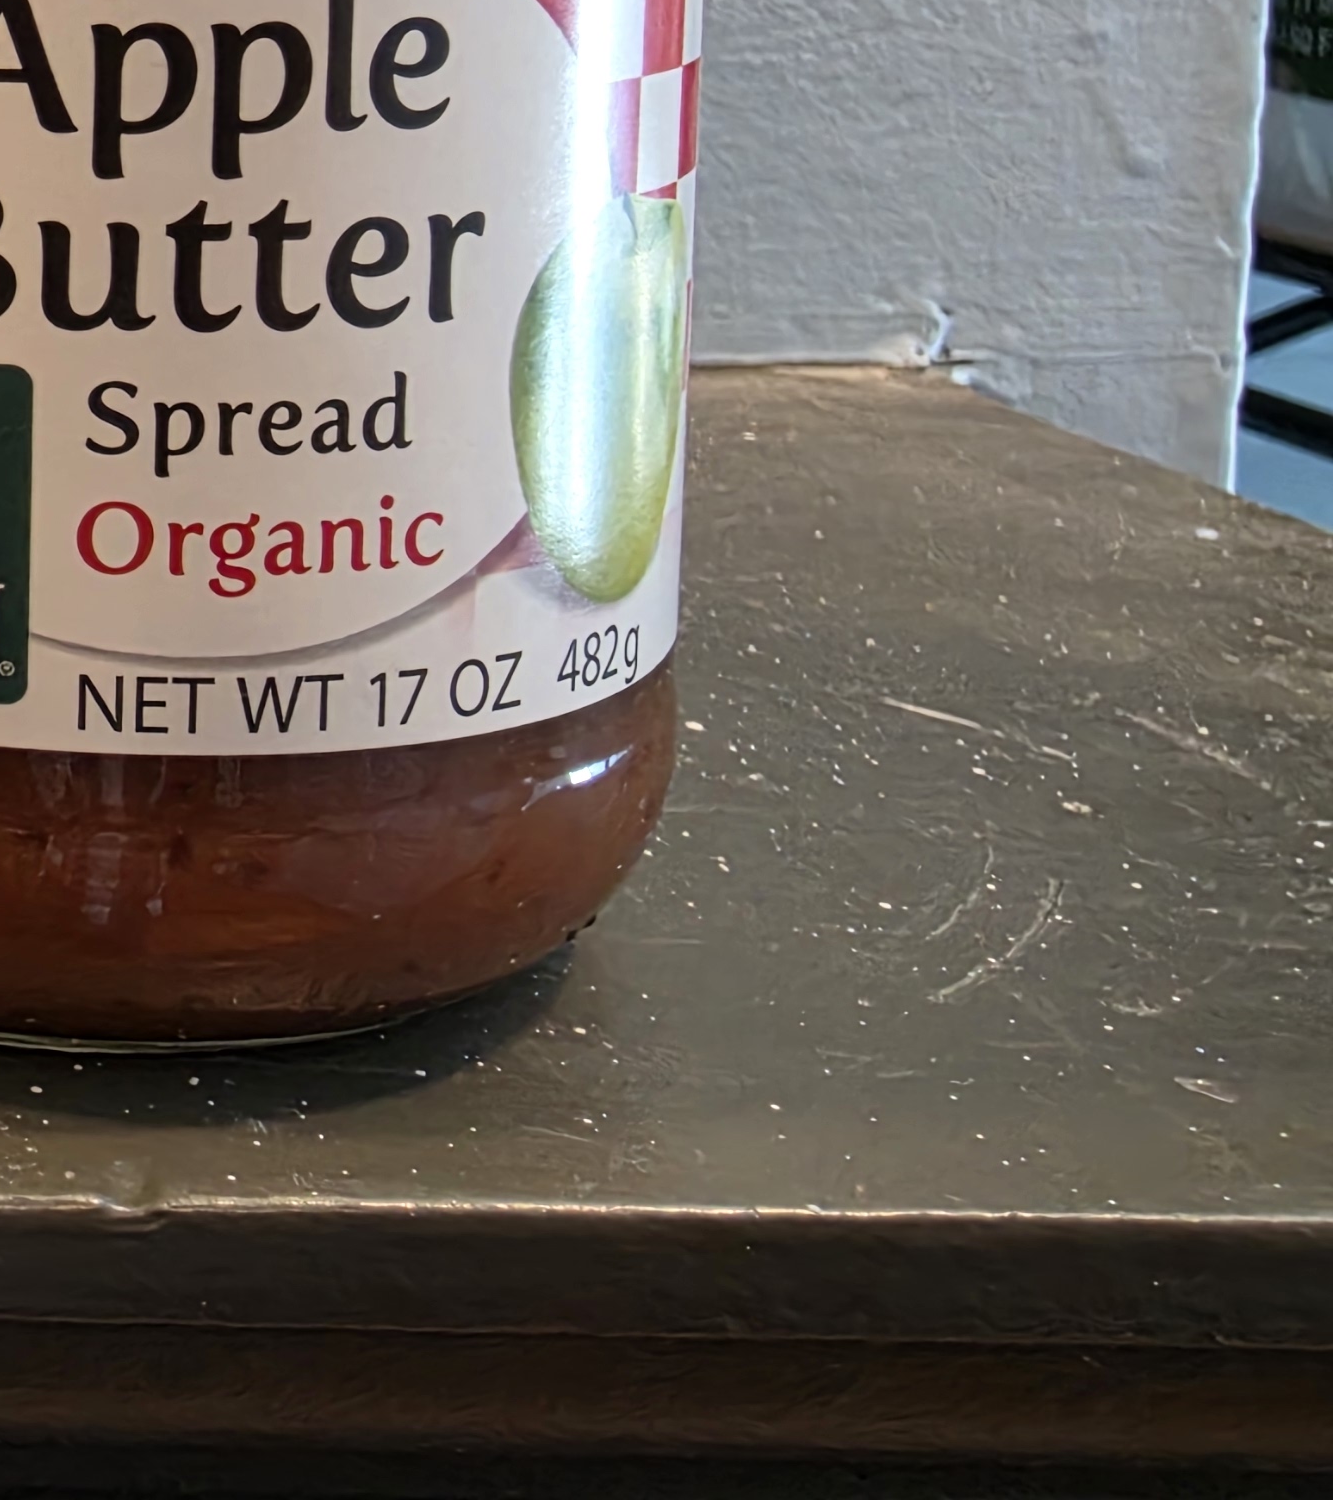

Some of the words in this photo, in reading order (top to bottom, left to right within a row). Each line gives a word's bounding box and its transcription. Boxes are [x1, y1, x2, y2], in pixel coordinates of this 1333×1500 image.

[85, 370, 413, 478] Spread
[76, 495, 445, 598] Organic
[77, 674, 216, 735] NET
[237, 674, 345, 734] WT
[369, 668, 429, 728] 17
[449, 650, 523, 719] OZ
[557, 623, 641, 692] 482g
